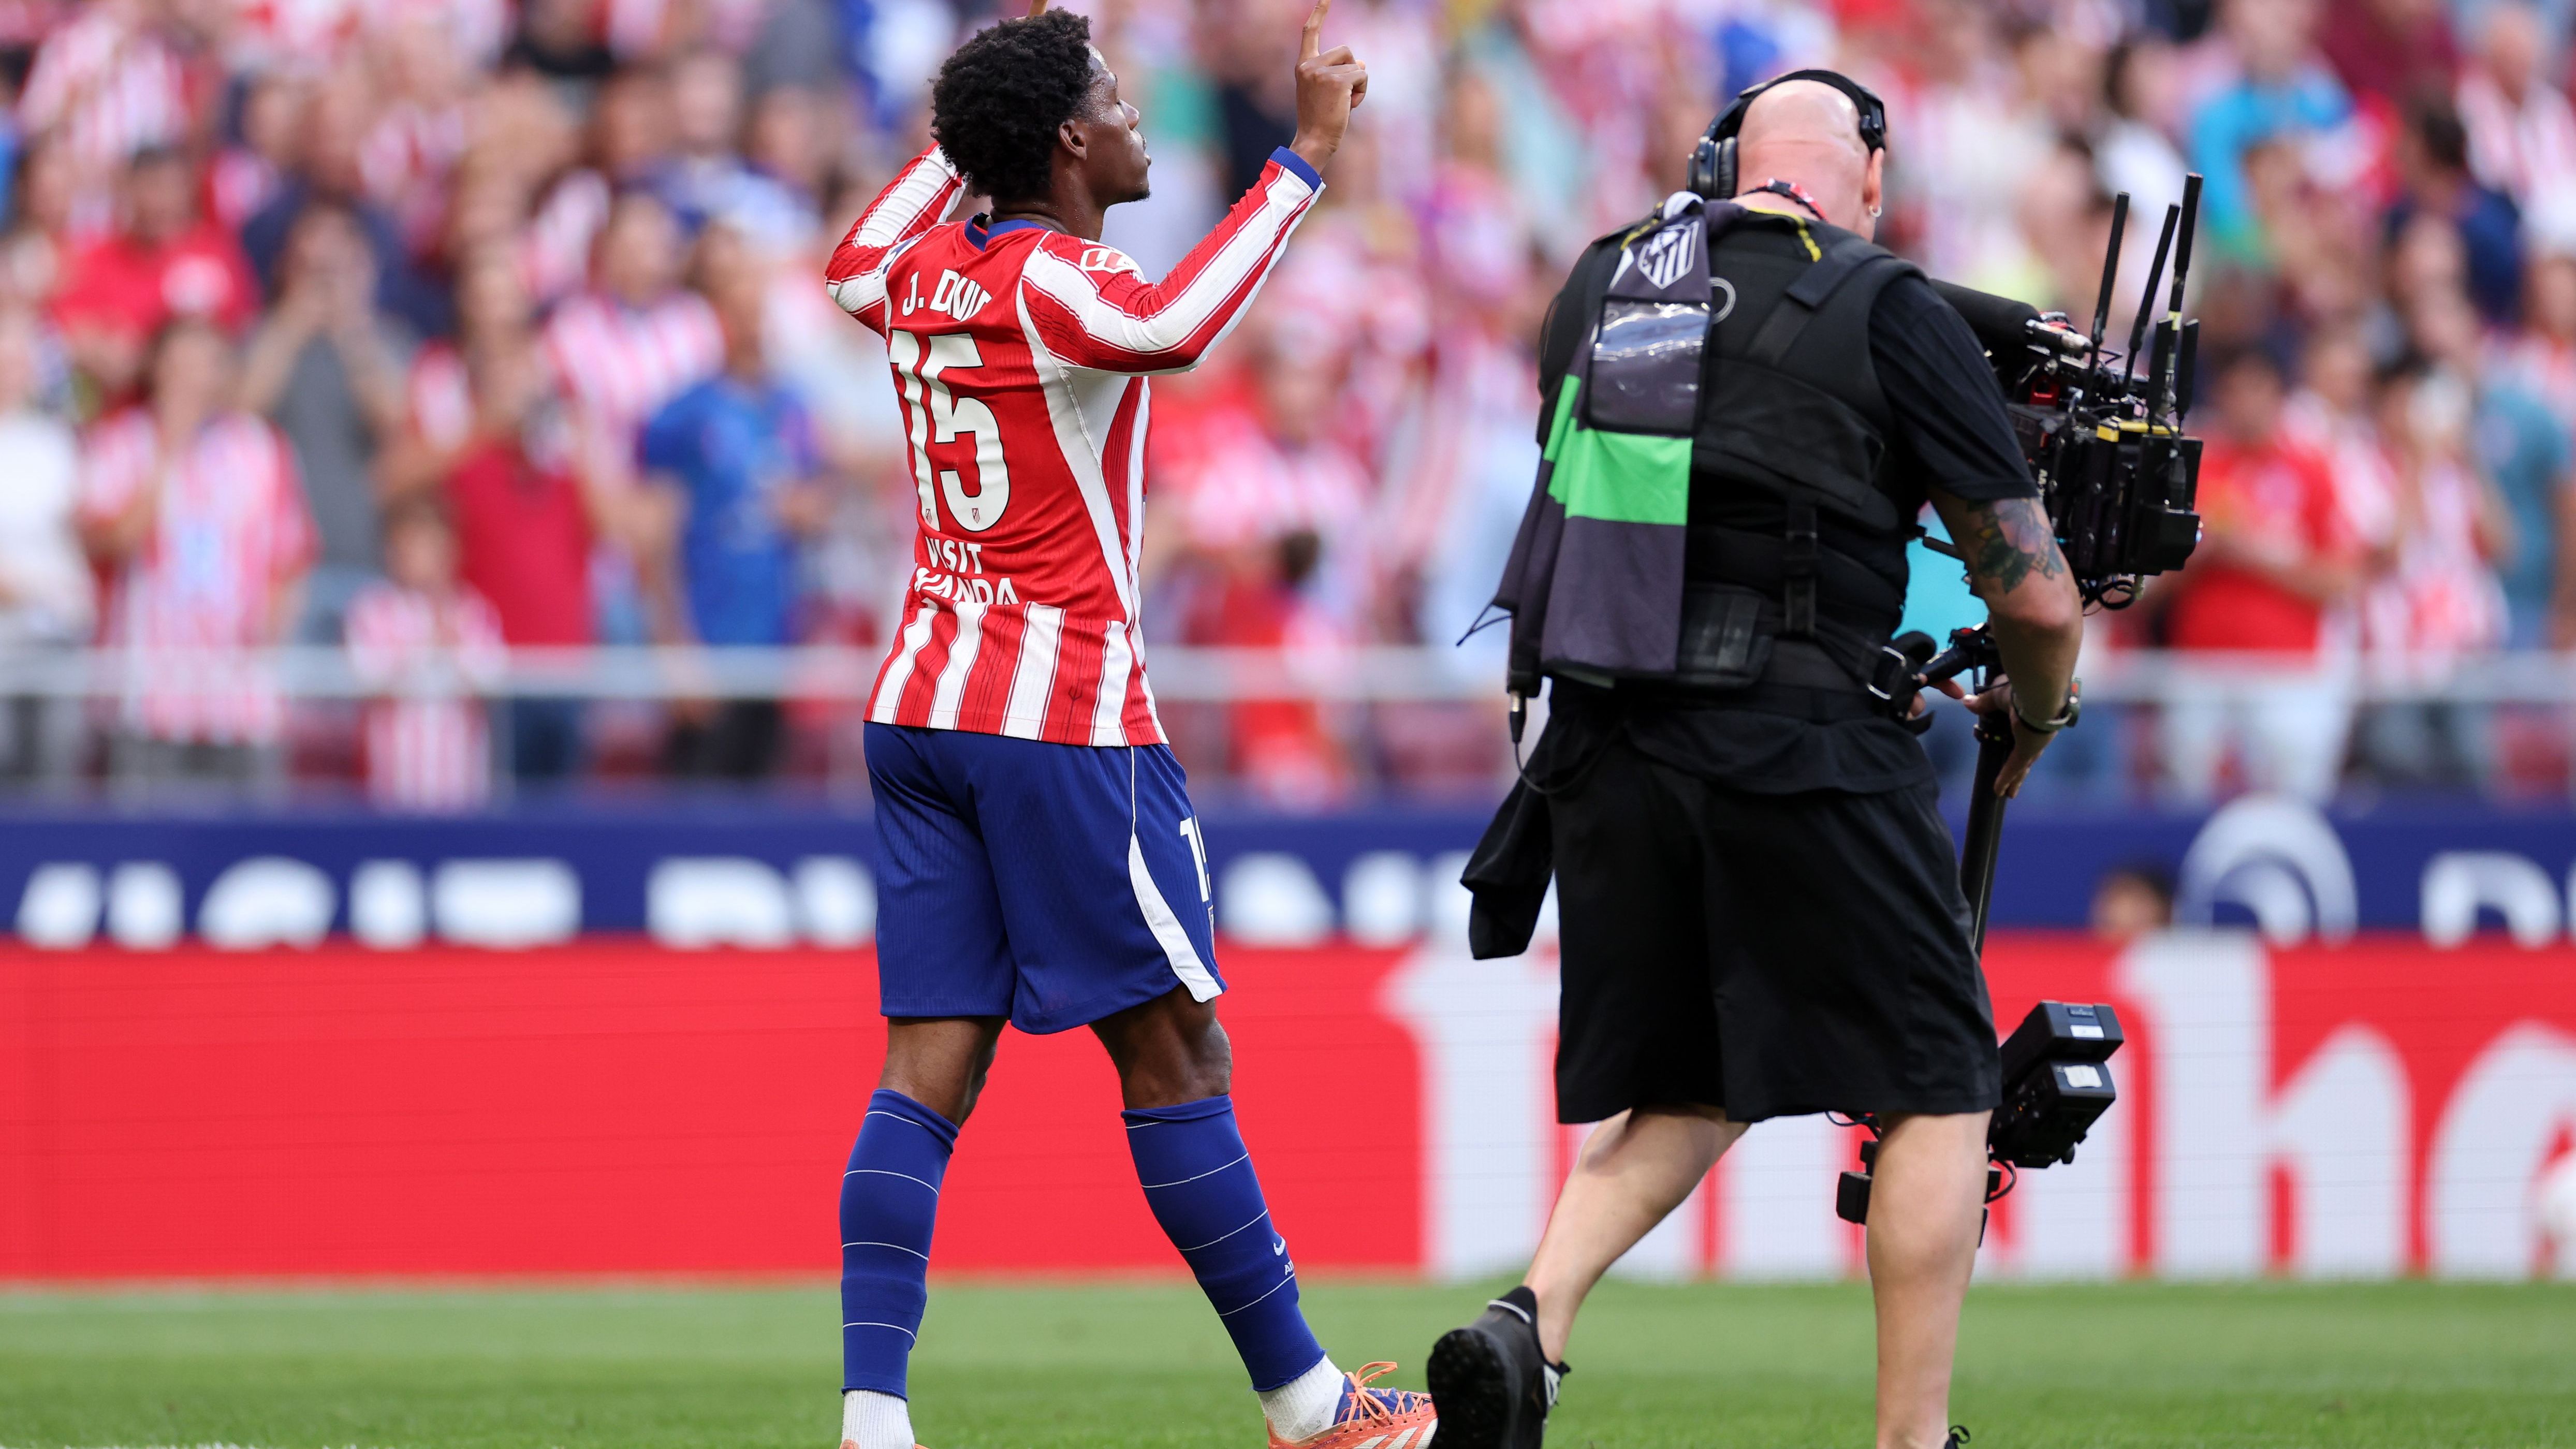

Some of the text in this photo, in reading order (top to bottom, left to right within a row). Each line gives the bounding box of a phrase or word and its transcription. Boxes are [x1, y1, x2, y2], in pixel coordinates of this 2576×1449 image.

[902, 271, 925, 316] J.
[889, 329, 1010, 532] 15
[1180, 814, 1212, 903] 1
